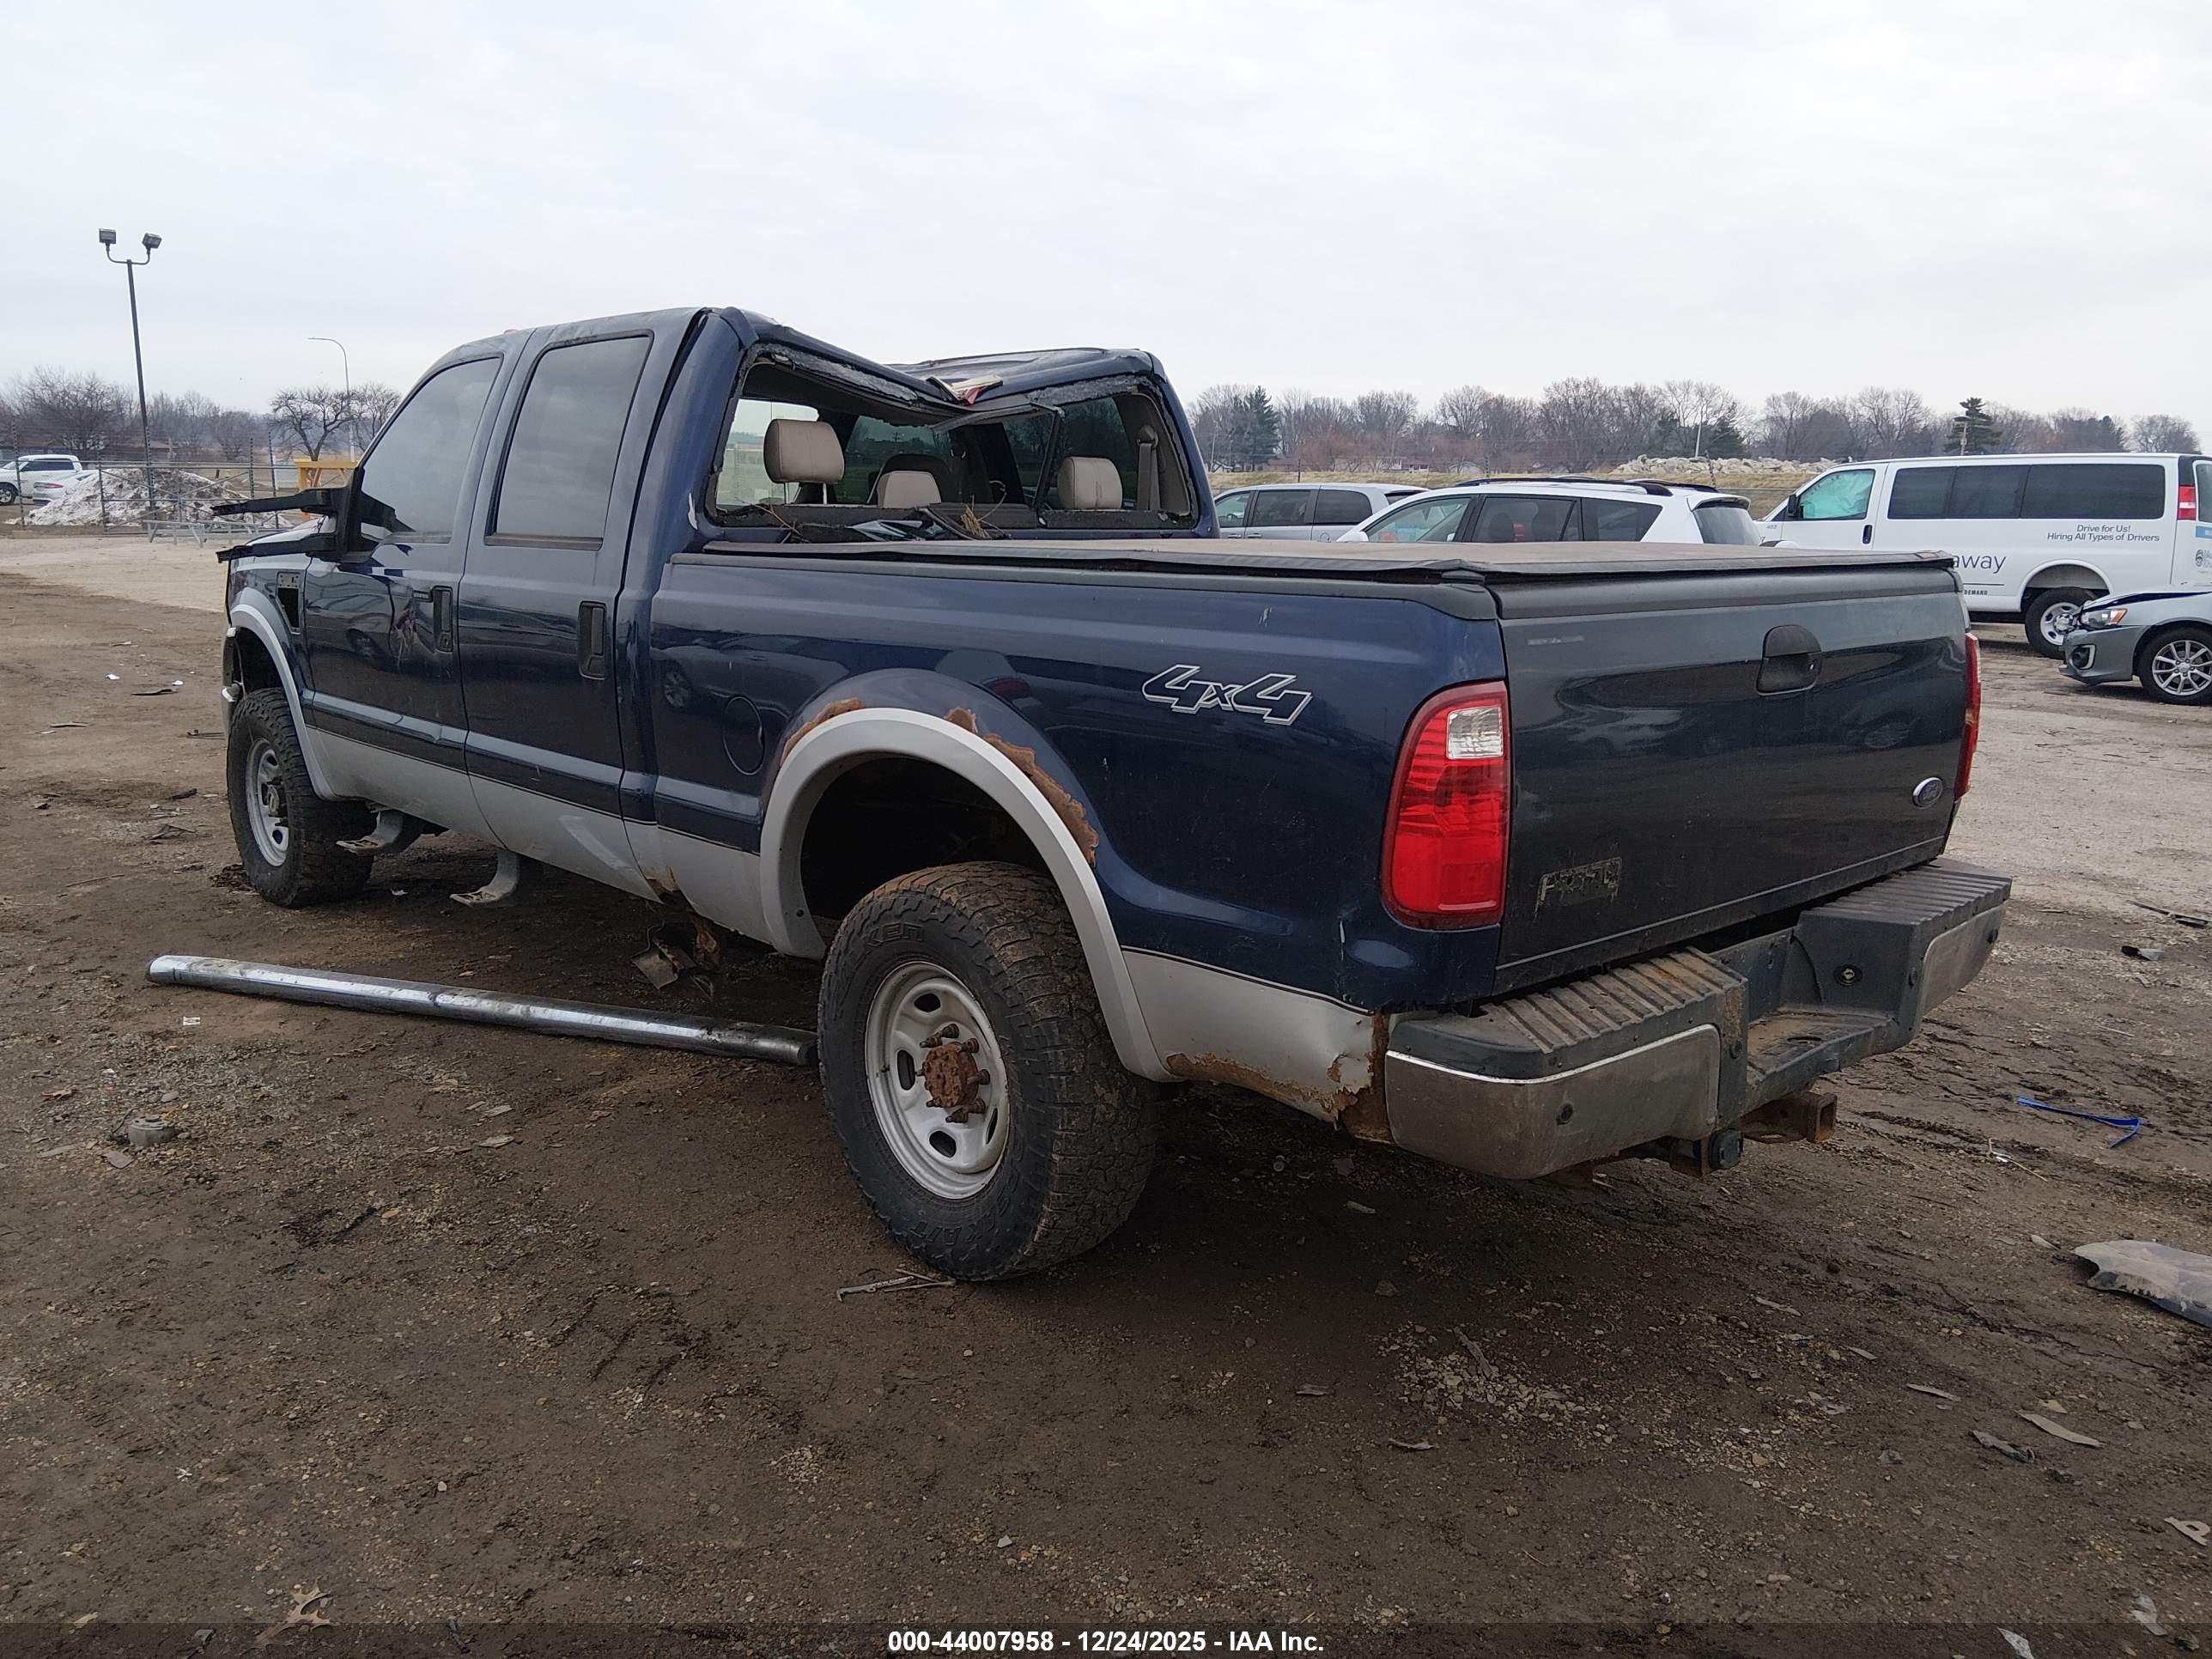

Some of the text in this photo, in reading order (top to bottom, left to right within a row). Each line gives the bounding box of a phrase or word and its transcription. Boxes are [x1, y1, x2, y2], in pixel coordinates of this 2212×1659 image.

[2076, 524, 2100, 532] Drive
[2101, 524, 2114, 532] for
[2047, 532, 2073, 542] Hiring
[2088, 532, 2113, 542] Types
[2115, 532, 2124, 541] of
[2127, 533, 2160, 542] Drivers
[1142, 664, 1313, 726] 4x4
